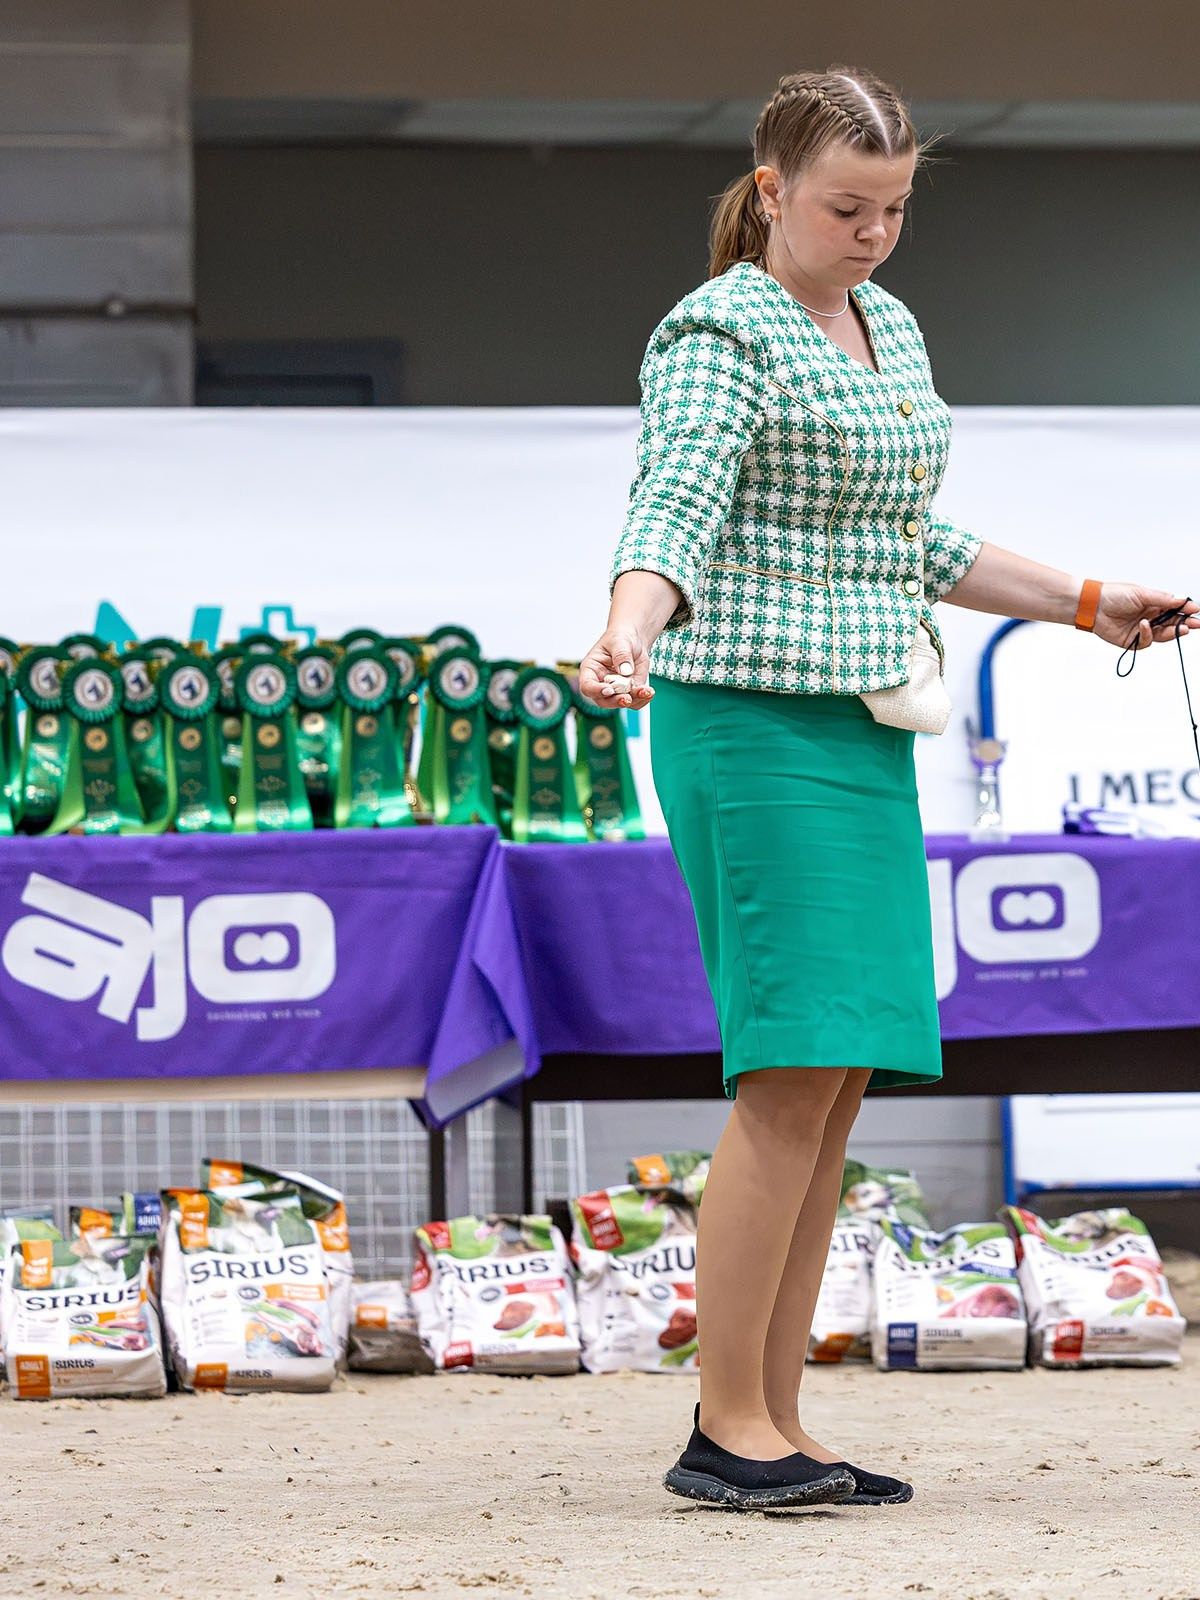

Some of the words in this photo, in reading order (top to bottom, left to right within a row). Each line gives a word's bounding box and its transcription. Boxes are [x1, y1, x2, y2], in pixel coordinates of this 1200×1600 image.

[190, 1254, 309, 1285] SIRIUS
[26, 1285, 141, 1311] SIRIUS
[55, 1359, 95, 1369] SIRIUS
